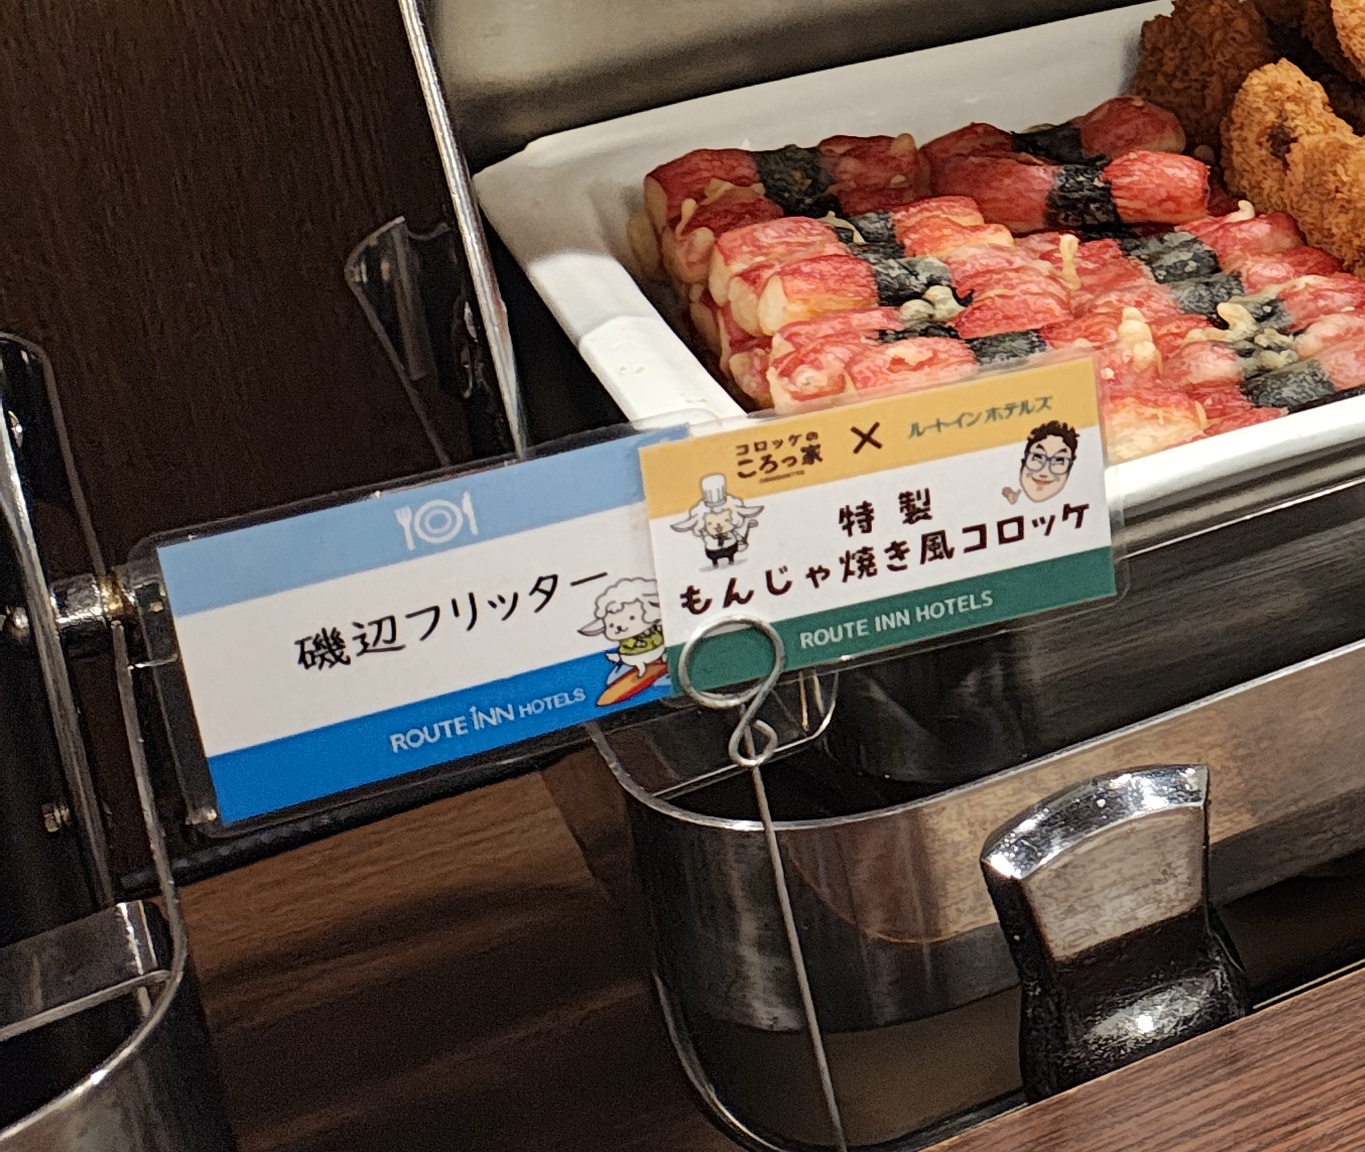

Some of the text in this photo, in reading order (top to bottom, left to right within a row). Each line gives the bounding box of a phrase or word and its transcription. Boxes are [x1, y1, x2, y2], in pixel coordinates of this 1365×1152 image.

[736, 431, 819, 457] コロッケの
[737, 444, 824, 479] ころっ家
[679, 502, 1091, 615] もんじゃ焼き風コロッケ
[294, 571, 608, 671] 磯辺フリッター
[800, 590, 994, 649] ROUTE INN HOTELS
[390, 687, 586, 753] ROUTE INN HOTELS
